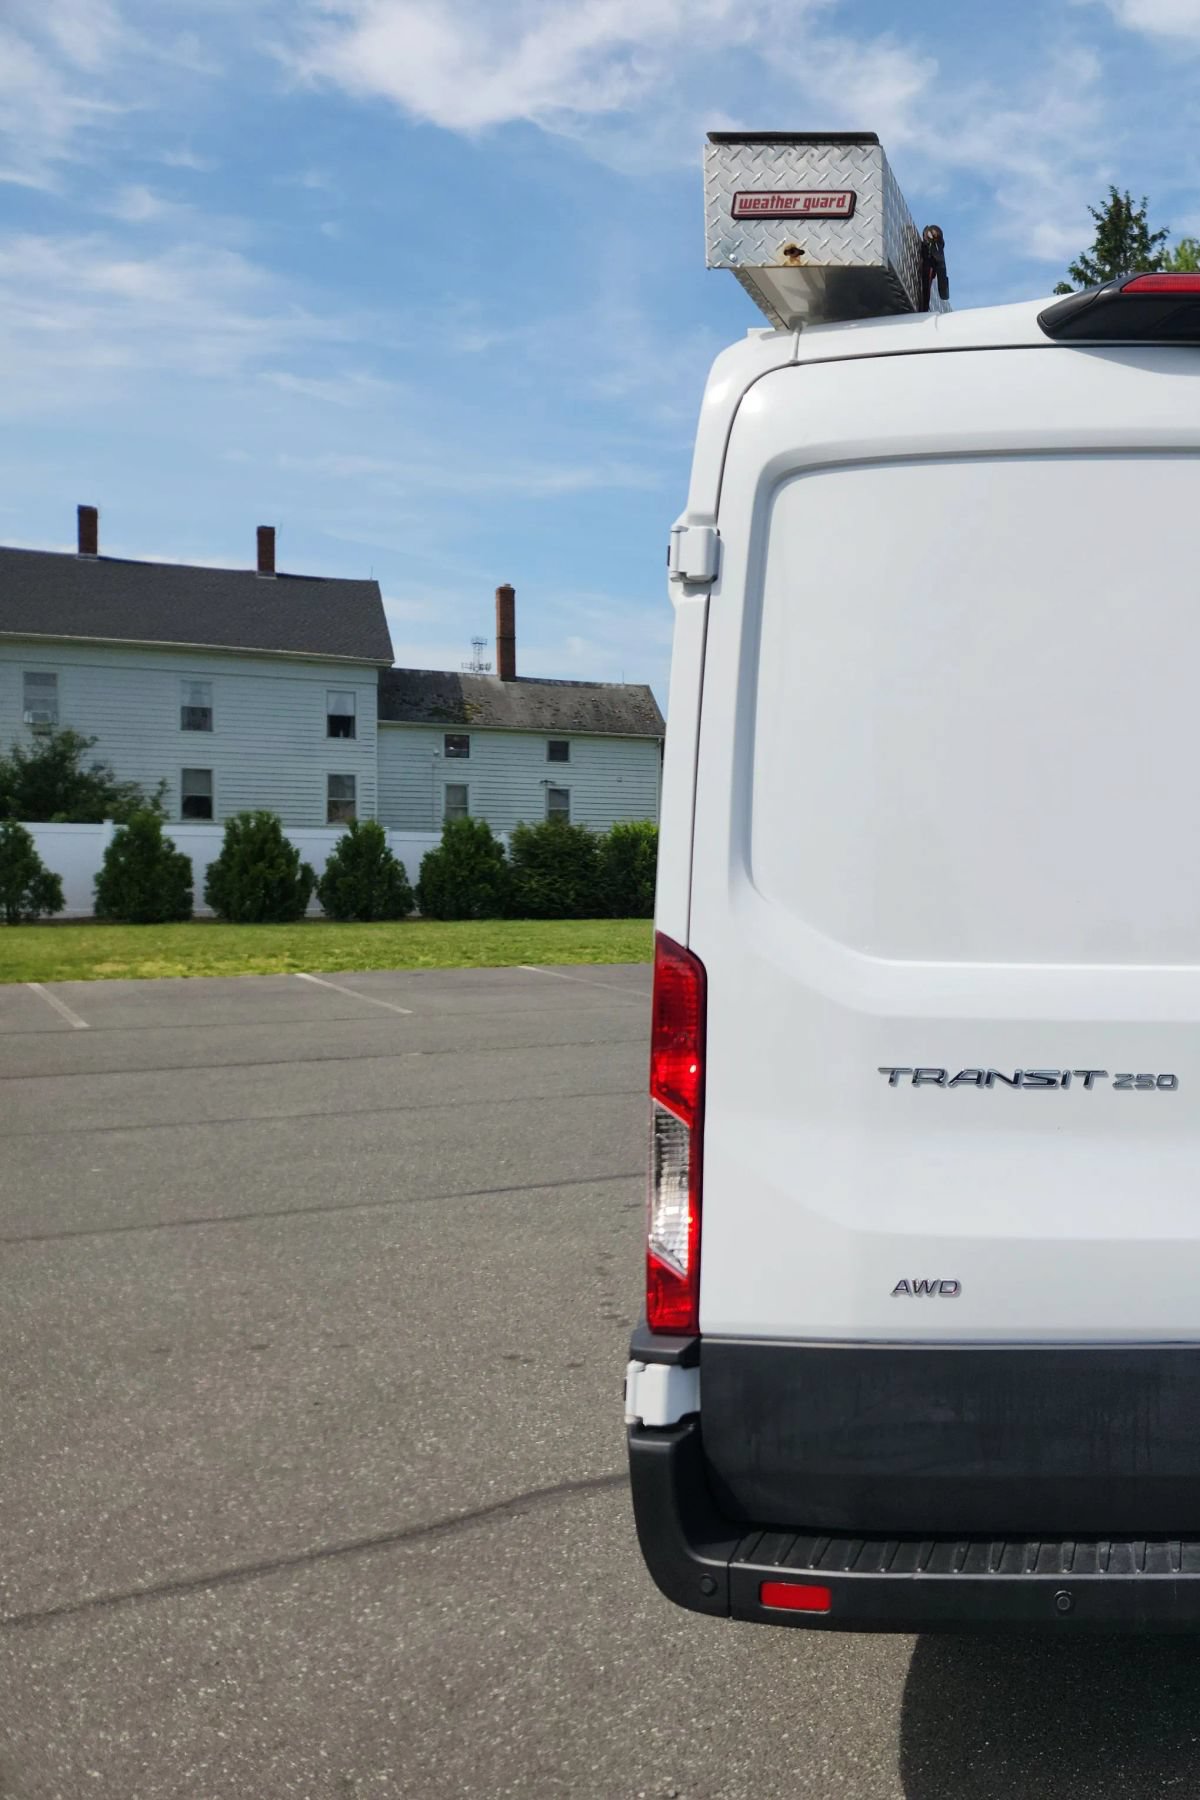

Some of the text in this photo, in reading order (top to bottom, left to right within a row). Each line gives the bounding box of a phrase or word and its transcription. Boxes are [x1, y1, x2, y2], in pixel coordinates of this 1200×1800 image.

[739, 194, 847, 212] weather guard
[878, 1067, 1177, 1090] TRANSIT 250
[890, 1279, 961, 1298] AWD
